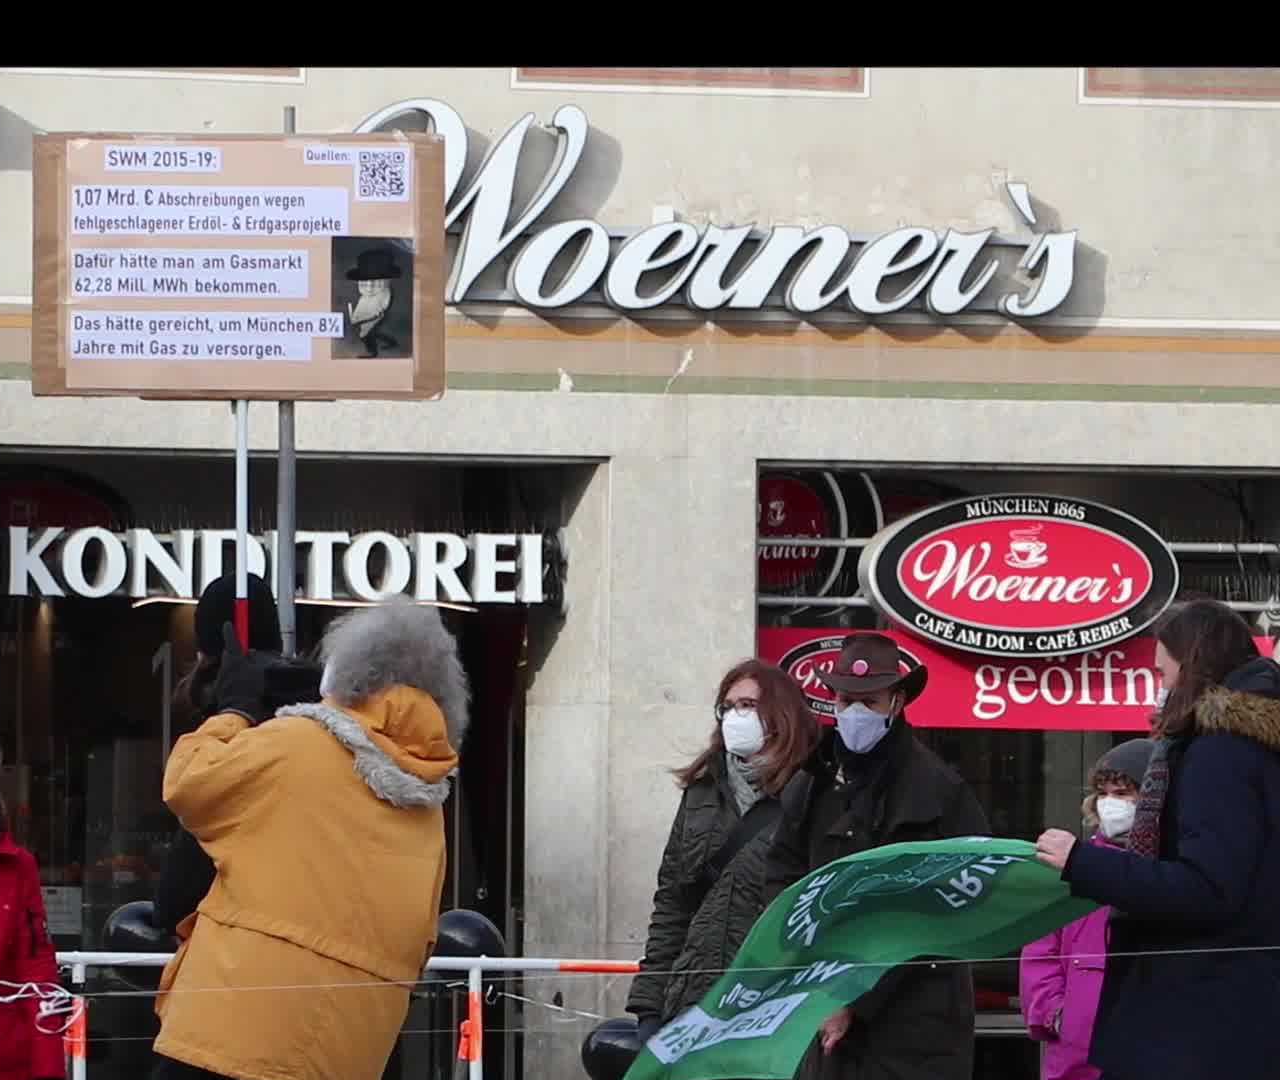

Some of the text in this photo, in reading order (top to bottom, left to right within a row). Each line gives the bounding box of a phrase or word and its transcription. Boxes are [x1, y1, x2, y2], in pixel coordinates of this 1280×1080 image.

[108, 150, 217, 169] SWM 2015-19:
[306, 149, 351, 161] Quellen:
[74, 188, 305, 211] 1,07 Mrd. € Abschreibungen wegen
[353, 98, 1078, 317] Woerner's
[73, 215, 342, 235] fehlgeschlagener Erdöl- & Erdgasprojekte
[74, 252, 303, 270] Dafür hätte man am Gasmarkt
[74, 277, 113, 295] 62,28
[152, 277, 189, 293] MWh
[194, 278, 281, 294] bekommen.
[74, 315, 102, 331] Das
[106, 315, 144, 332] hätte
[149, 316, 215, 336] gereicht,
[219, 320, 242, 332] um
[247, 316, 314, 333] München
[73, 340, 287, 360] Jahre mit Gas zu versorgen.
[966, 498, 1087, 521] MÜNCHEN 1865
[912, 539, 1134, 604] Woerner's
[915, 612, 1133, 651] CAFÉ AM DOM CAFÉ REBER
[971, 649, 1157, 720] geöffn
